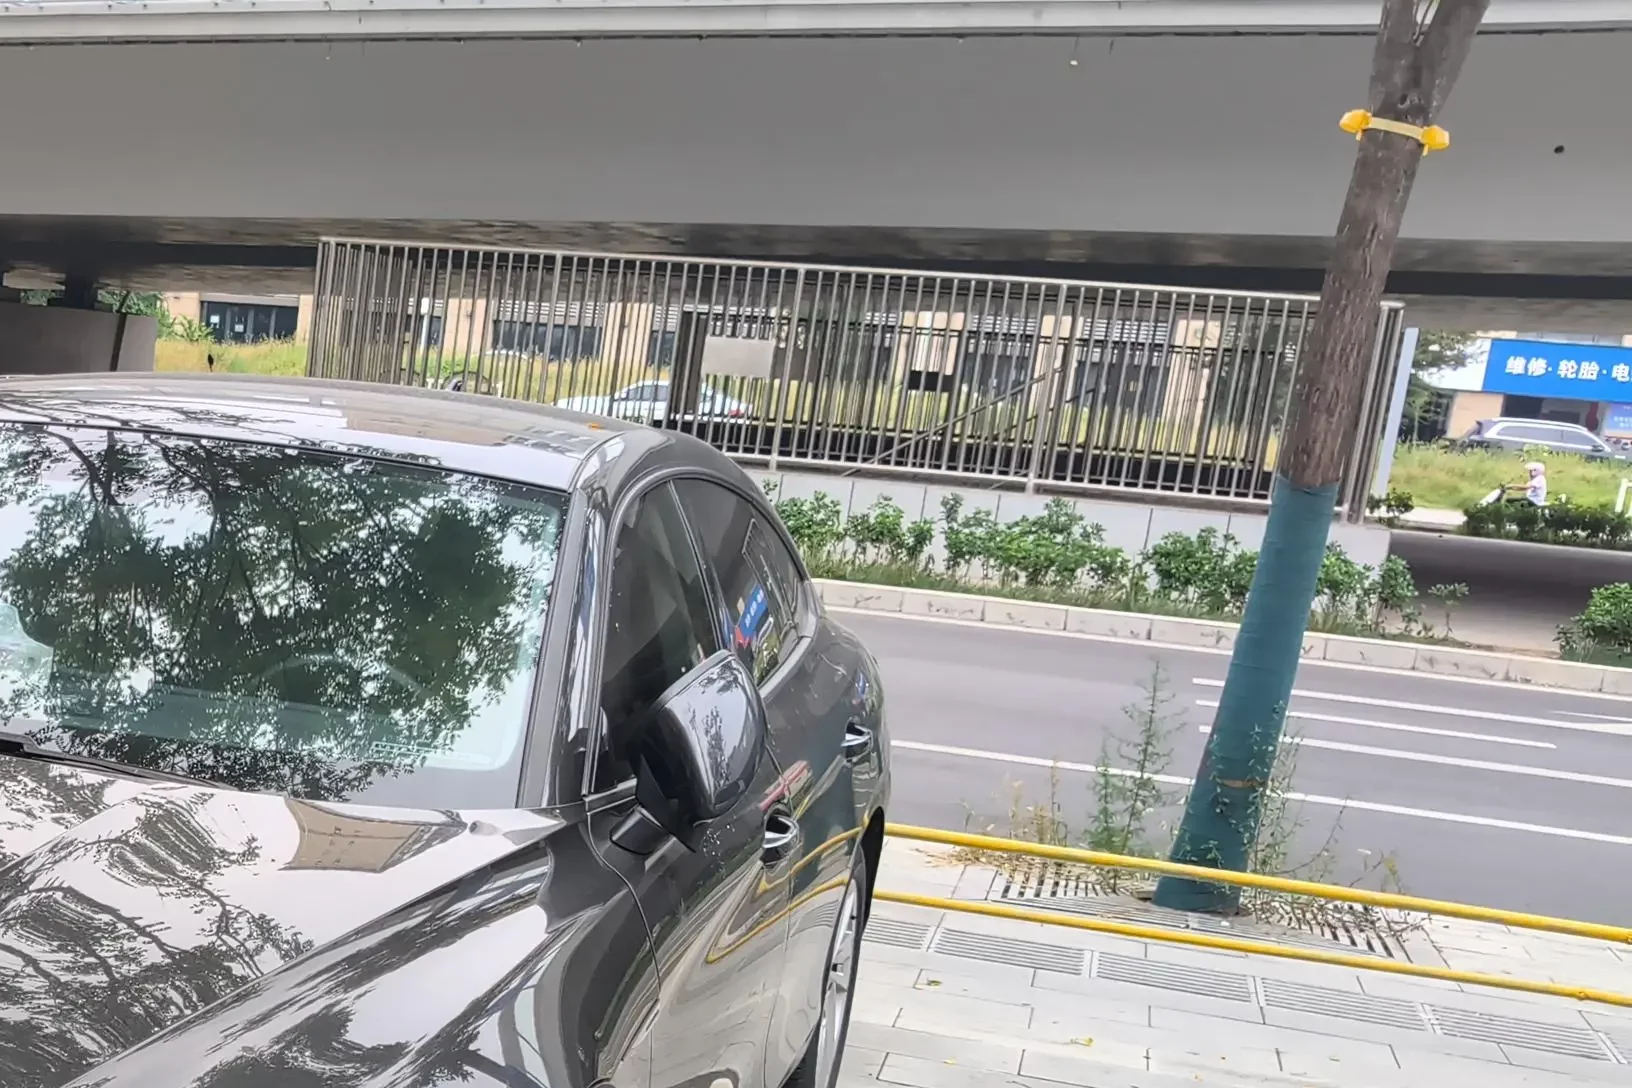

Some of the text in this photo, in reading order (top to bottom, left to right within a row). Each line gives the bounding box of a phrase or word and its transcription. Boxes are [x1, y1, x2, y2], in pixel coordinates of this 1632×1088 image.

[1505, 355, 1632, 383] 维修·轮胎·电
